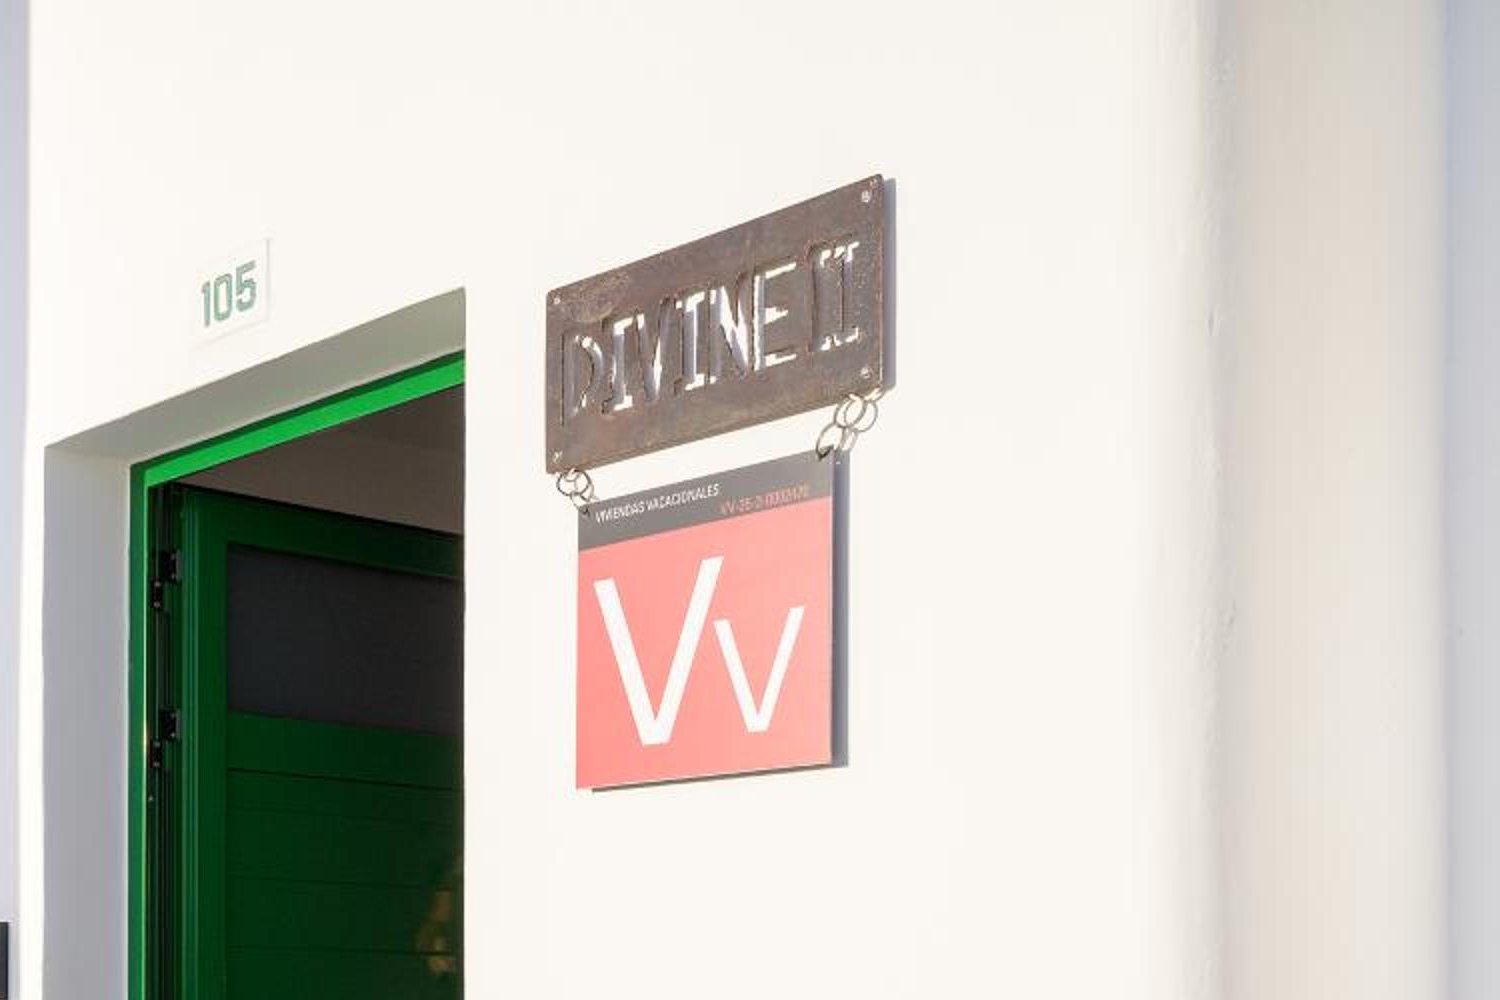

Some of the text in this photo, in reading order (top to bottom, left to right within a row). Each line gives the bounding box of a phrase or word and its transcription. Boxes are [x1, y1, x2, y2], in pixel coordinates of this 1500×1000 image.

[201, 259, 257, 328] 105
[561, 255, 798, 428] DIVINE
[595, 483, 720, 523] VIVIENDAS VACACIONALES
